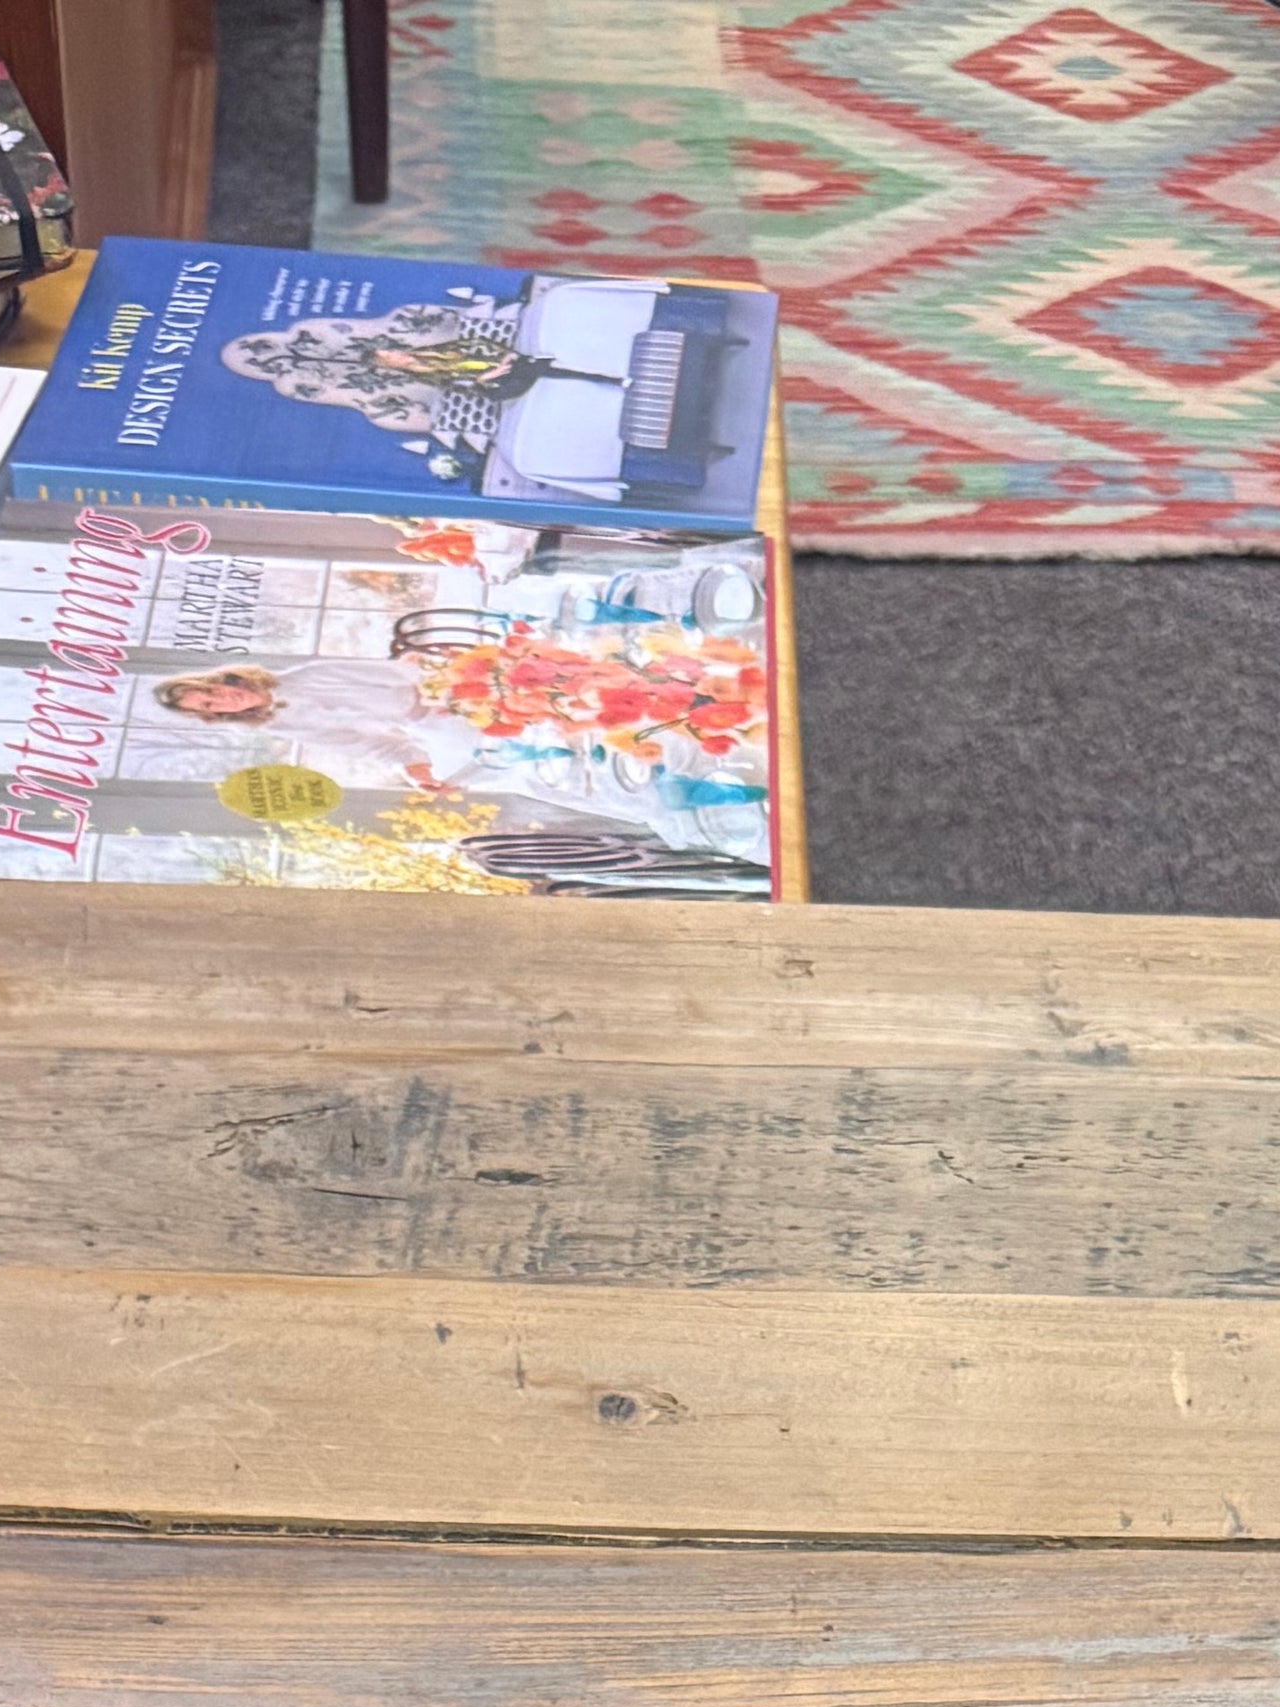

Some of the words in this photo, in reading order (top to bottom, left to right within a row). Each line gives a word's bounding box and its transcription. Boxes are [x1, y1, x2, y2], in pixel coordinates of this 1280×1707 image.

[77, 362, 125, 390] Kit
[90, 303, 155, 357] Kemp
[116, 359, 185, 446] DESIGN
[151, 260, 222, 356] SECRETS
[173, 559, 224, 654] MARTHA
[211, 553, 266, 656] STEWART
